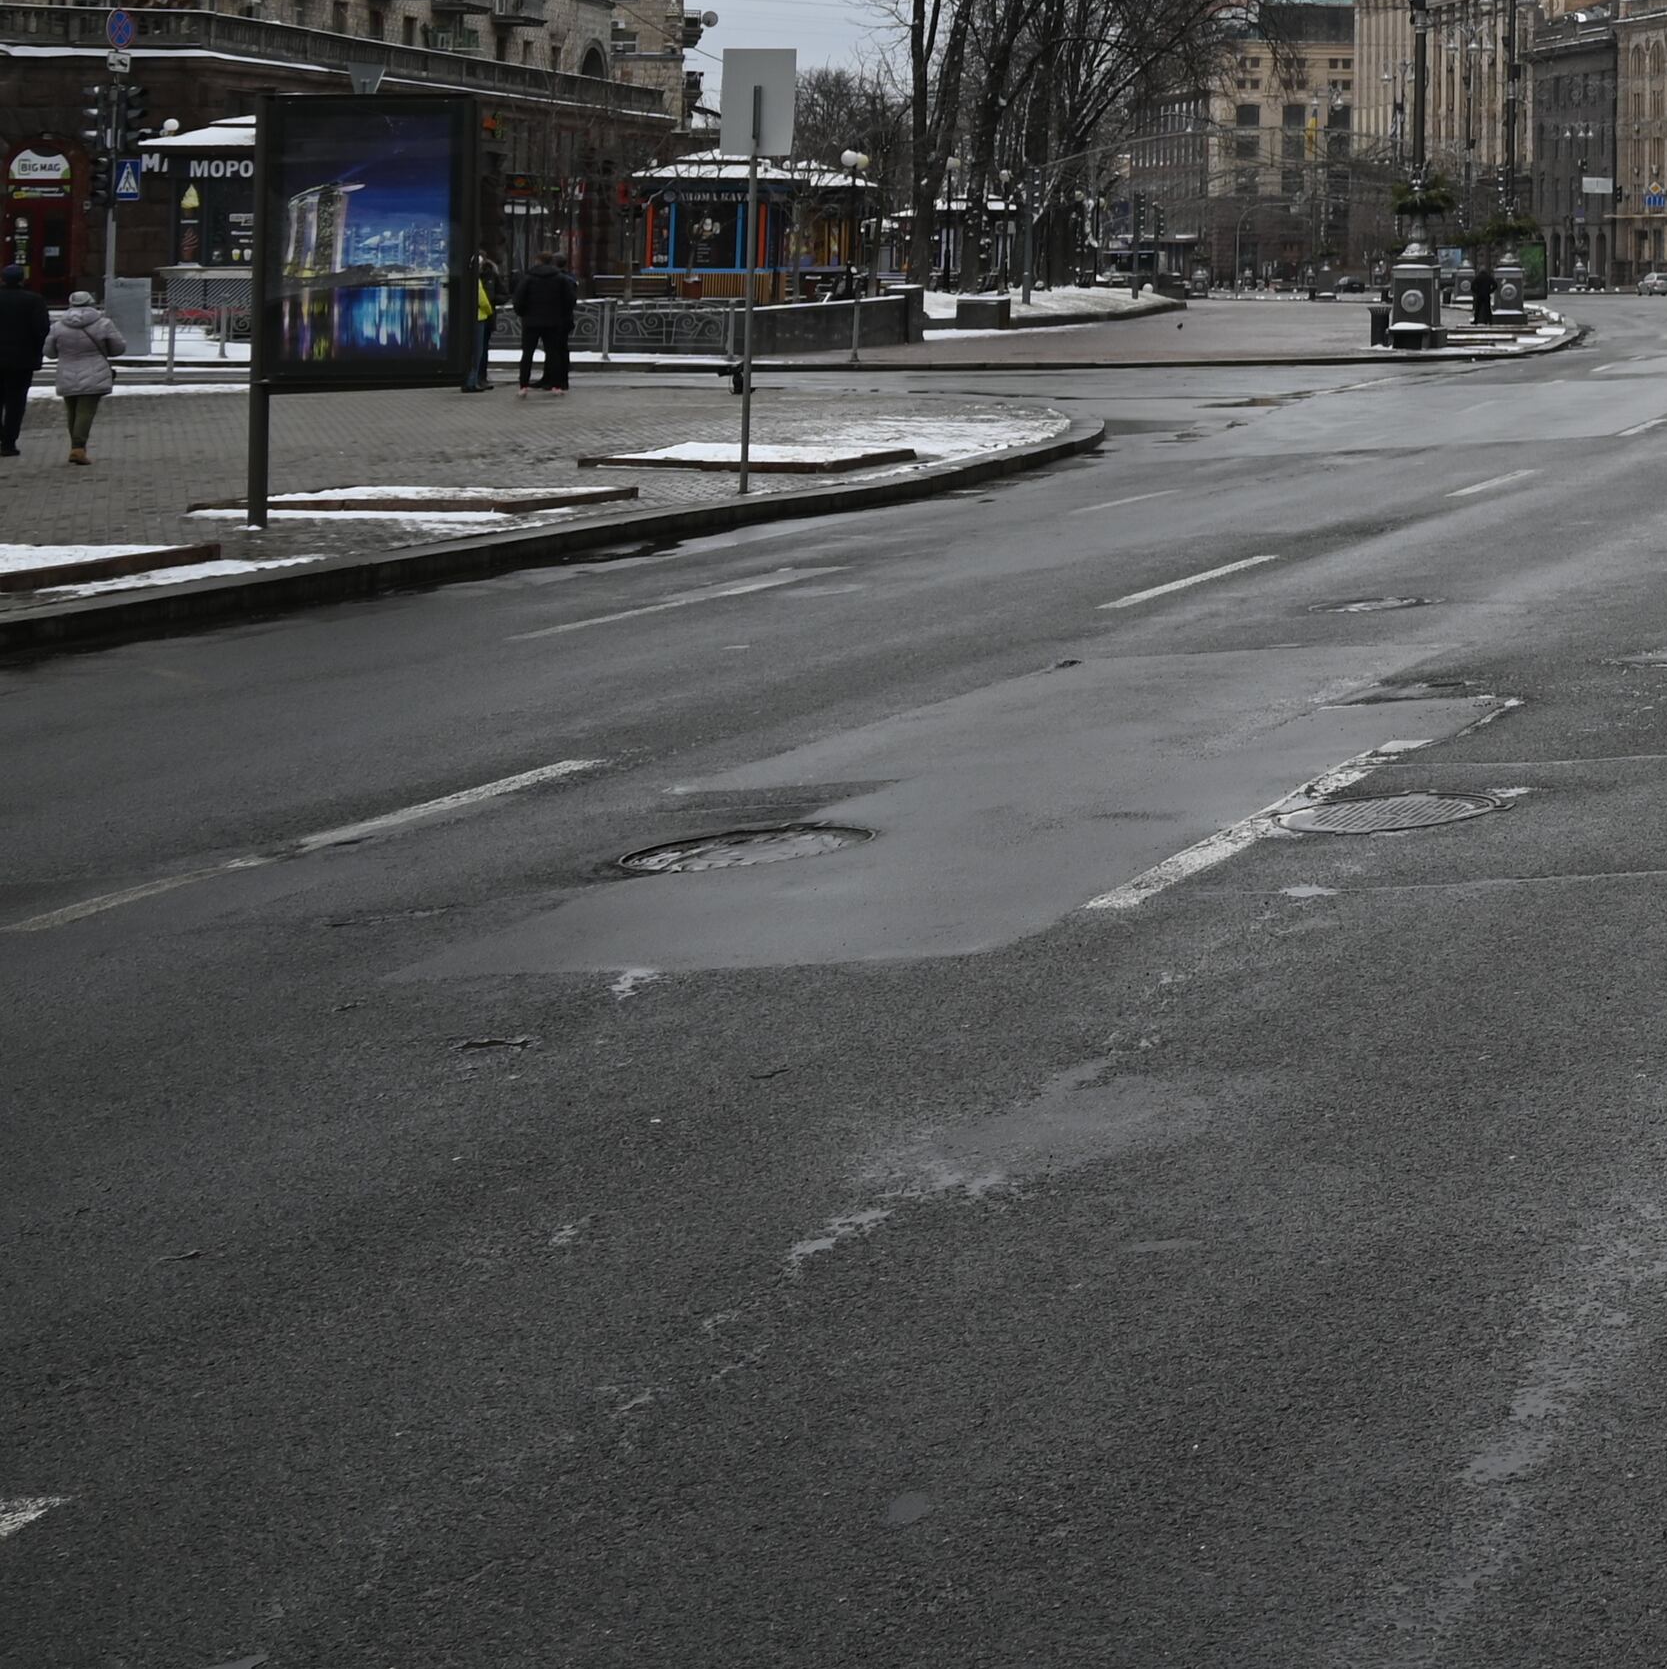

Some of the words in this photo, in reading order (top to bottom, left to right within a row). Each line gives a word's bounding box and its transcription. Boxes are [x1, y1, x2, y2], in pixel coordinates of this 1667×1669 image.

[20, 163, 39, 172] BIG
[40, 163, 61, 172] MAG
[189, 160, 254, 178] МОРО
